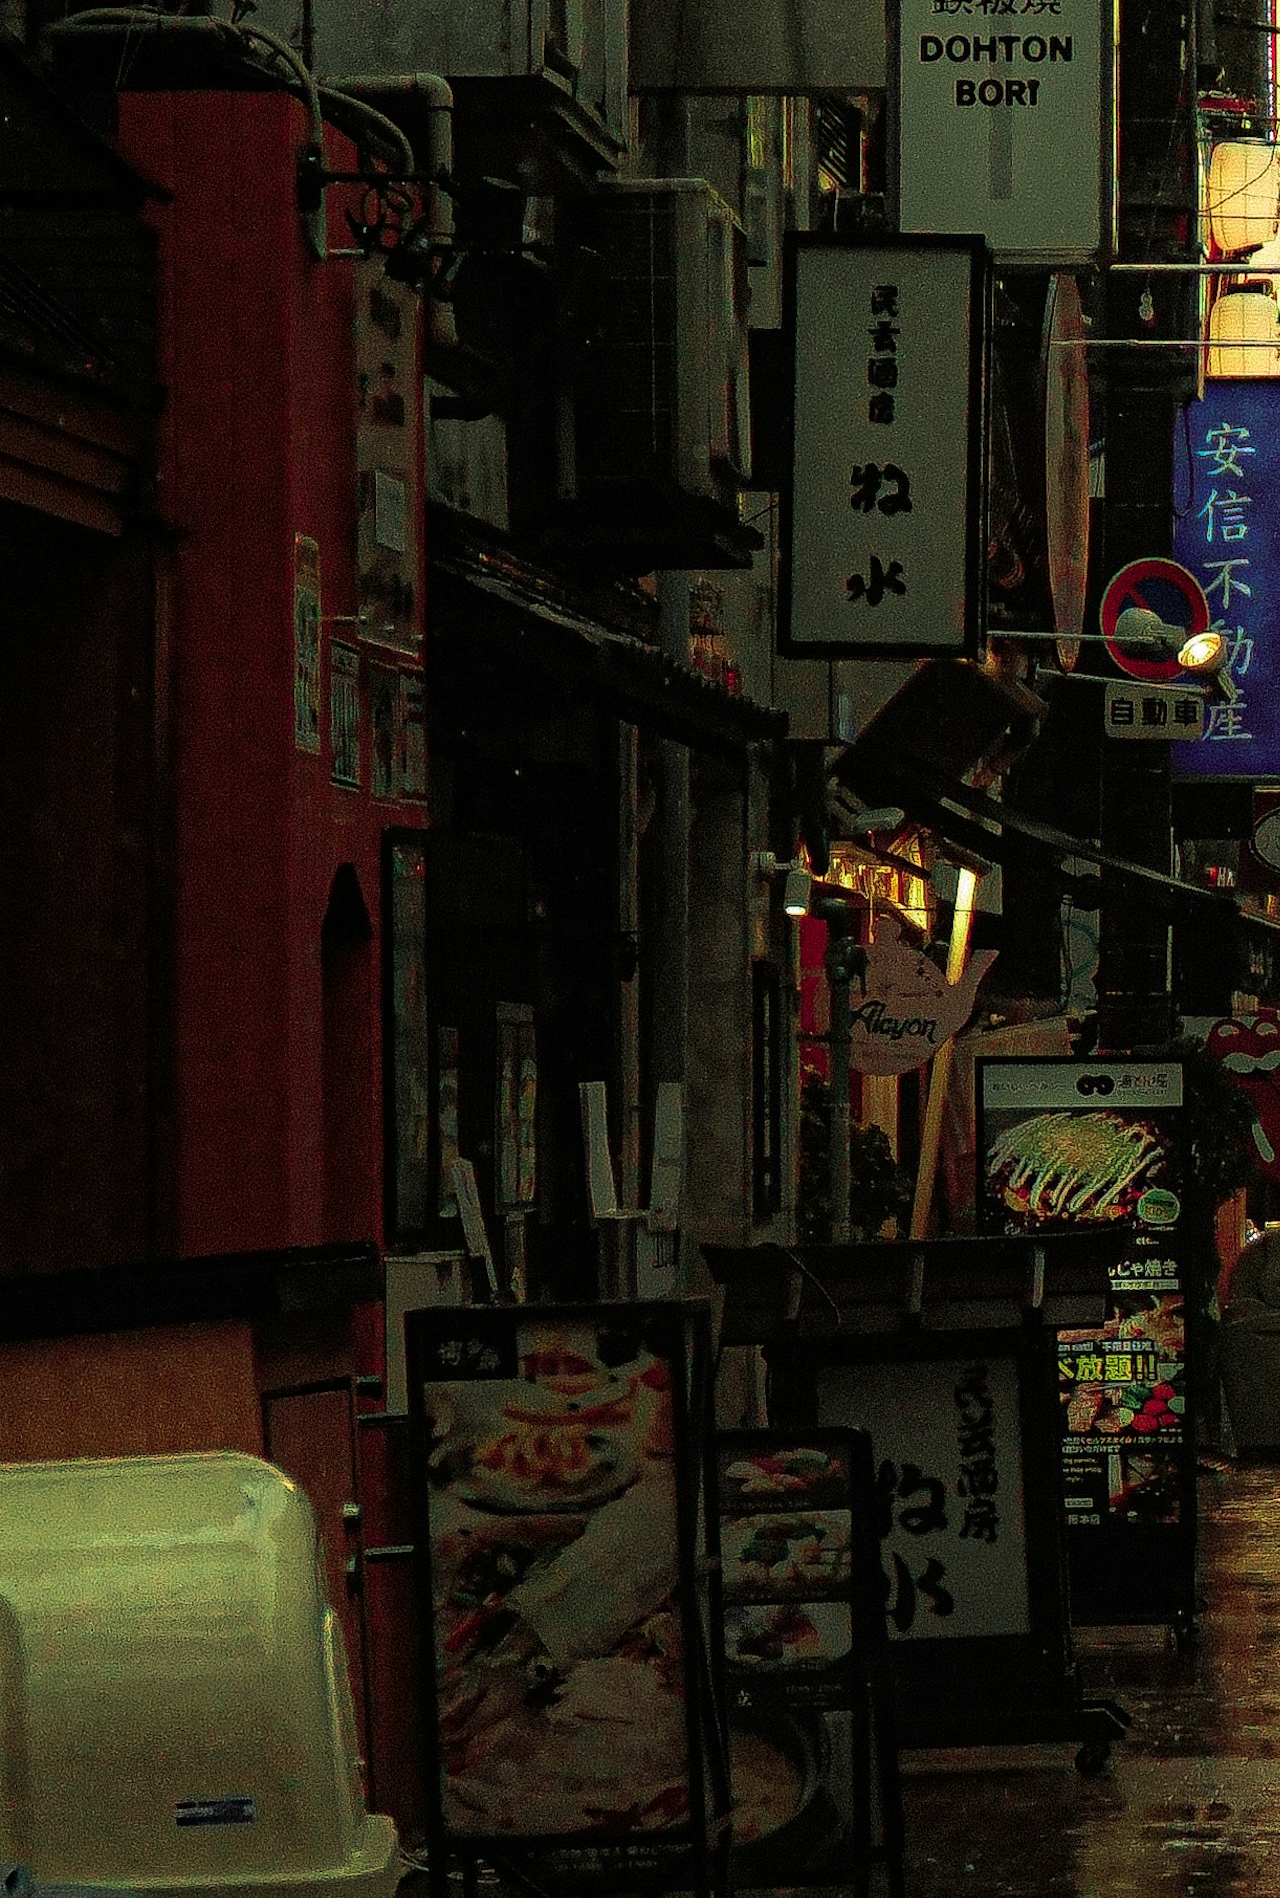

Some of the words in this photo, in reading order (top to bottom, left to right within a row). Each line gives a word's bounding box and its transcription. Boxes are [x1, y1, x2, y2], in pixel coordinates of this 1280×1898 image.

[919, 35, 1073, 63] DOHTON
[955, 79, 1041, 107] BORI
[1110, 698, 1201, 729] 自動車
[848, 999, 939, 1046] Alcyon
